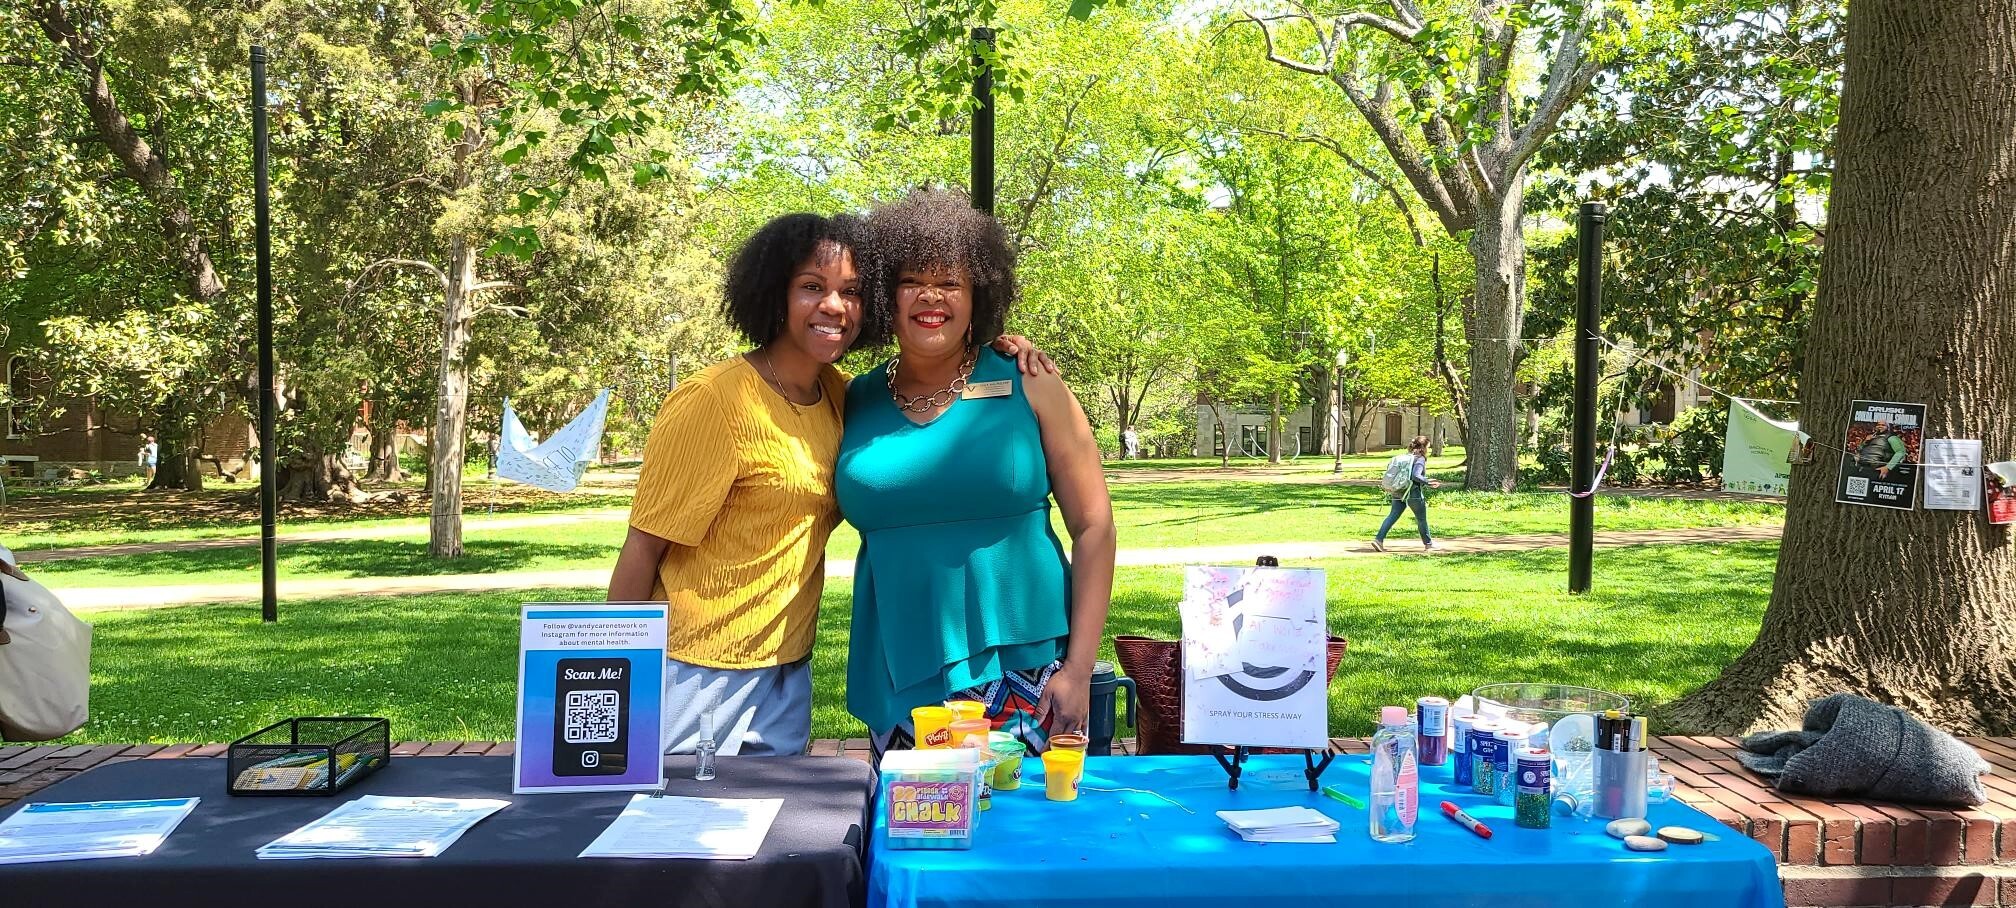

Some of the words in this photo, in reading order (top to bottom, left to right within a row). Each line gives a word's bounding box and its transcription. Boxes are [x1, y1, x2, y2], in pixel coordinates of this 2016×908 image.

[1868, 406, 1905, 414] DRUSKI
[1873, 485, 1895, 494] APRIL
[1896, 487, 1905, 496] 17
[567, 622, 637, 630] @vandycarenetwork
[606, 638, 631, 646] health.
[564, 668, 597, 680] Scan
[597, 667, 623, 680] Me!
[1209, 710, 1232, 718] SPRAY
[1254, 711, 1279, 719] STRESS
[1280, 712, 1302, 720] AWAY
[893, 801, 962, 823] CHALK
